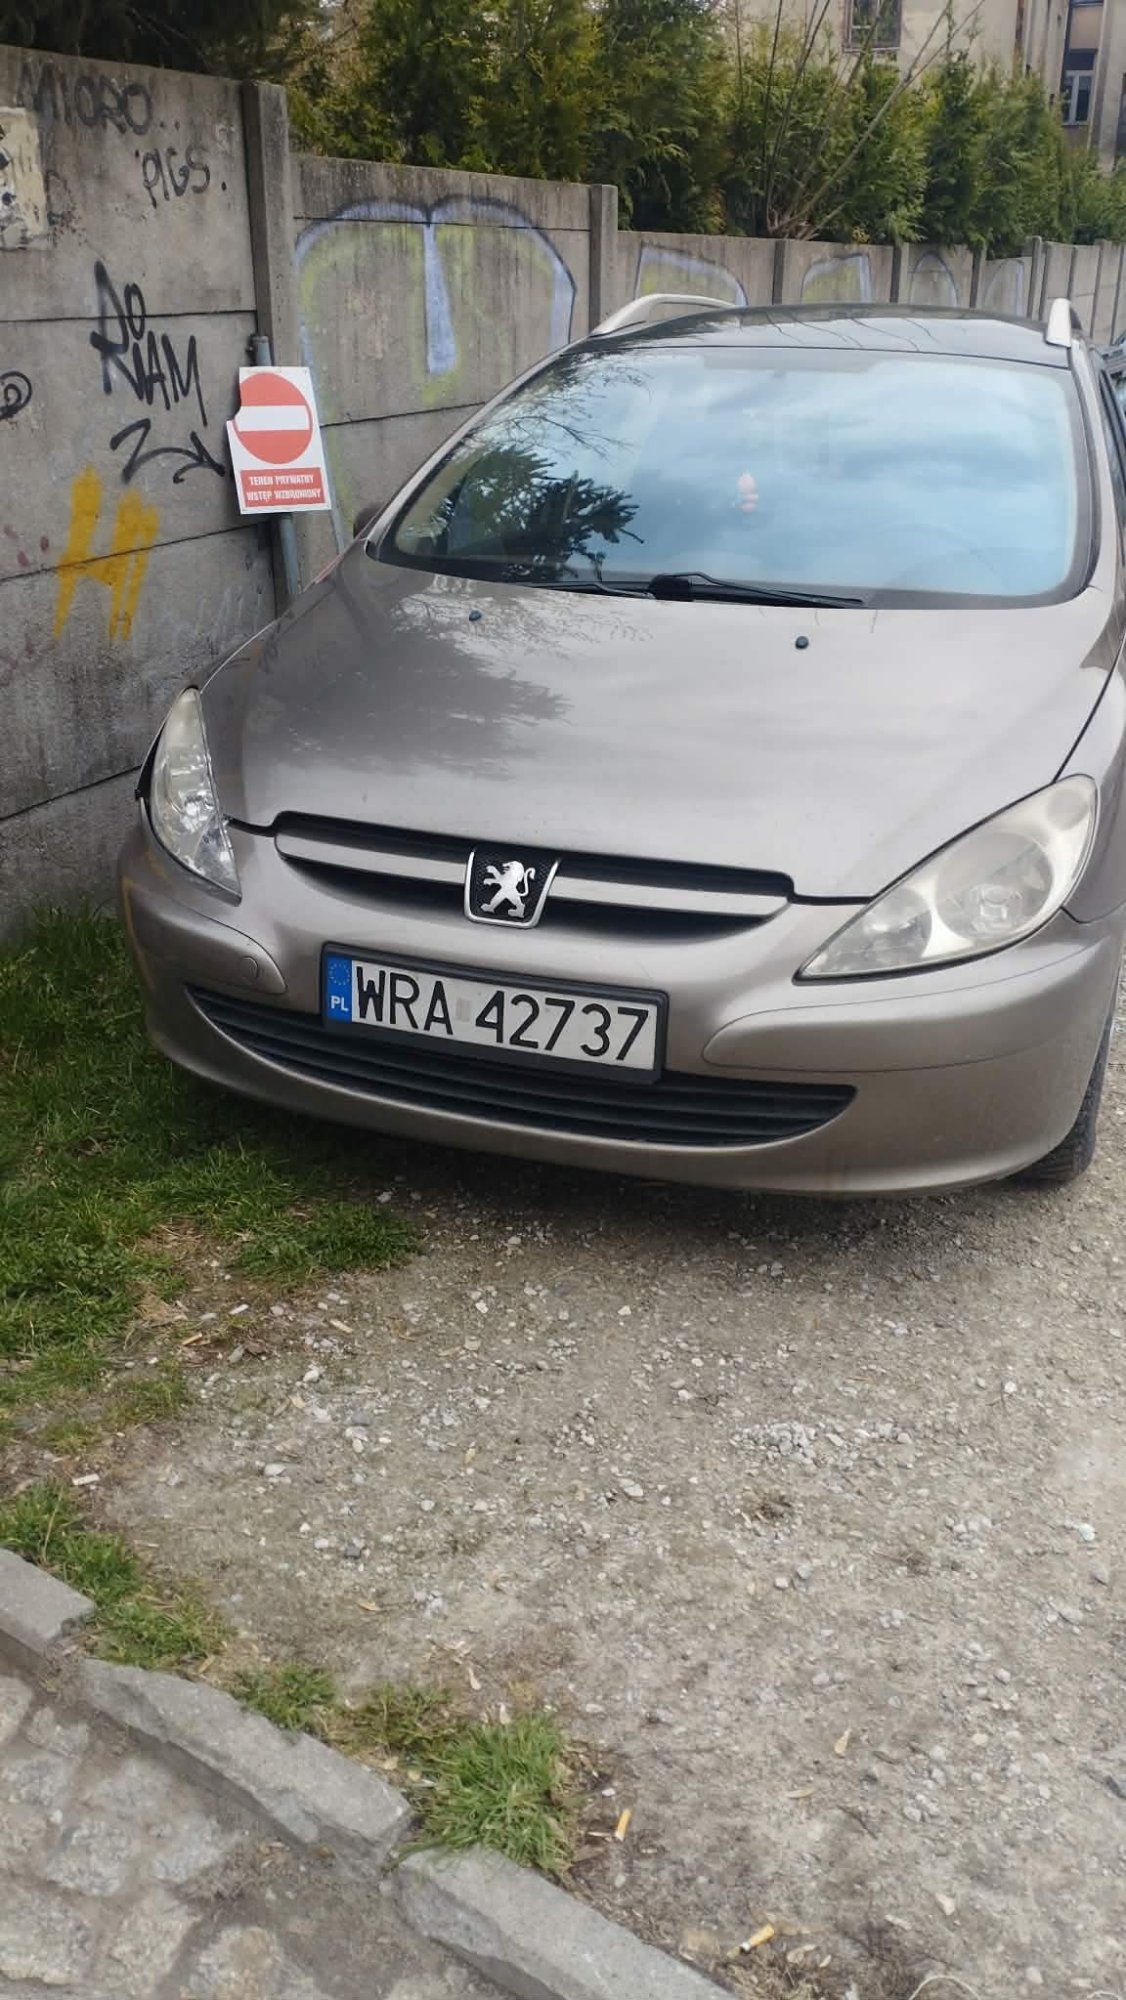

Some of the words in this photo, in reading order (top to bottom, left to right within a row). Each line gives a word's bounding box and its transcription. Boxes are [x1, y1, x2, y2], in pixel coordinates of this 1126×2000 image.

[330, 995, 349, 1012] PL
[356, 966, 453, 1035] WRA
[475, 990, 649, 1061] 42737
